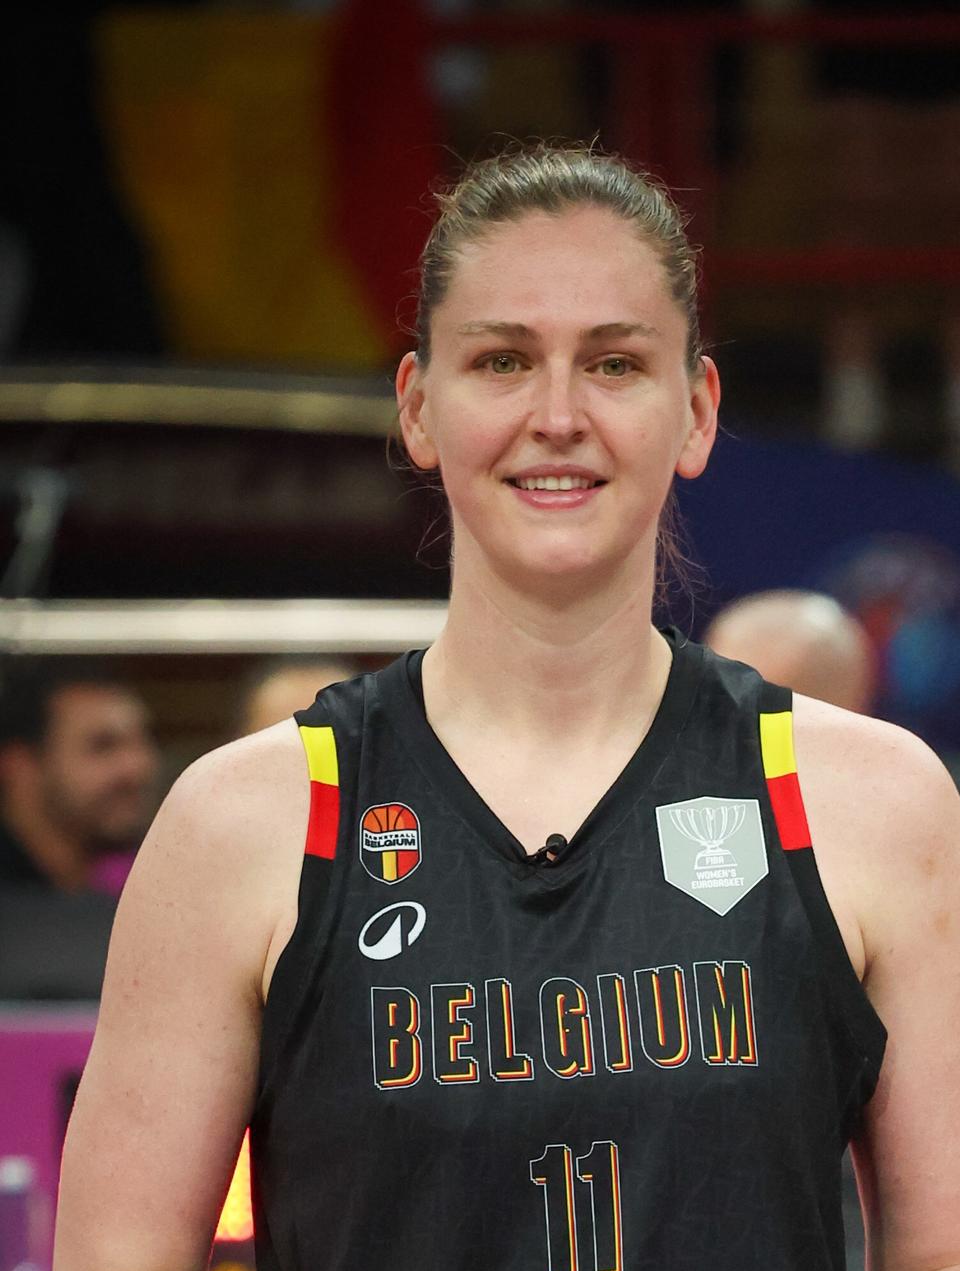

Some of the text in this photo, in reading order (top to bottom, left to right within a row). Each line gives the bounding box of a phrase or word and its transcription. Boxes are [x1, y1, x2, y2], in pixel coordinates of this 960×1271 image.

[365, 838, 415, 848] BELGIUM
[696, 869, 737, 880] WOMEN'S
[692, 878, 744, 889] EUROBASKET
[371, 960, 759, 1090] BELGIUM
